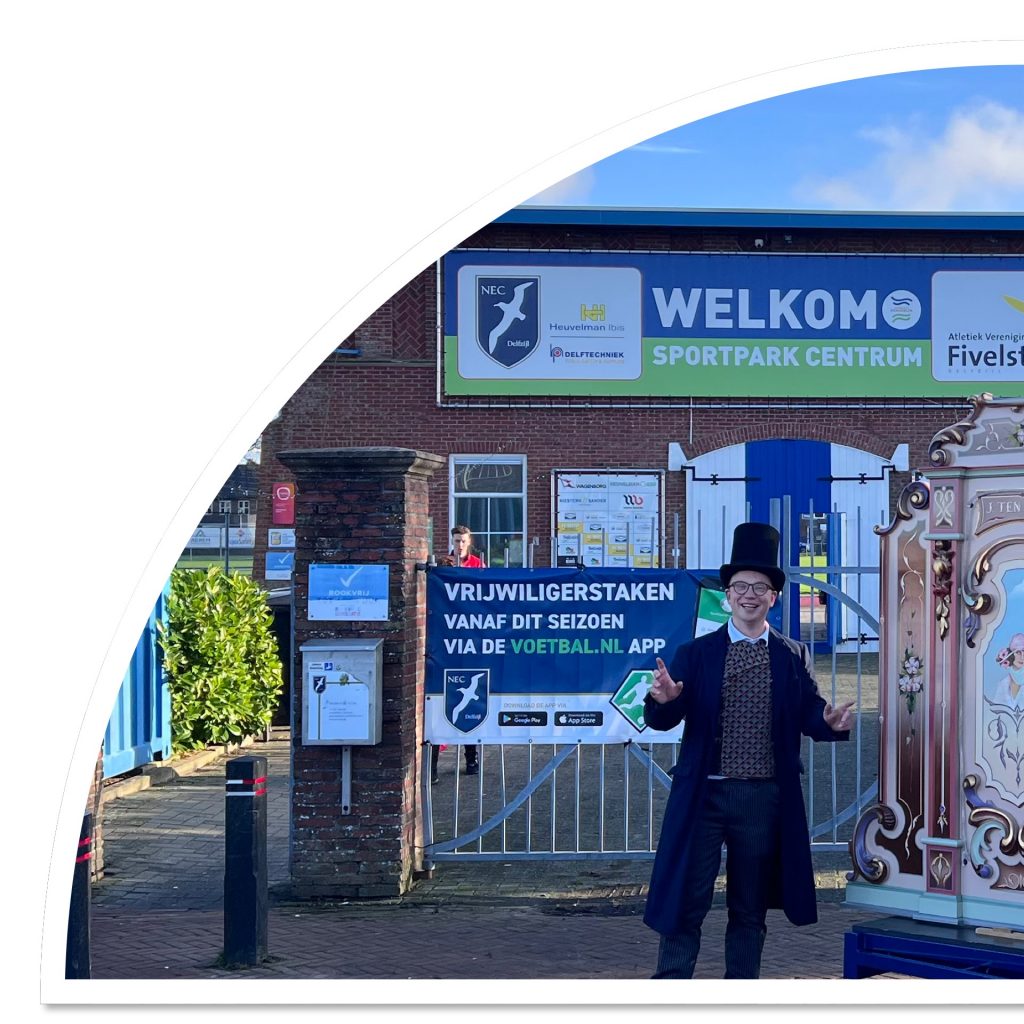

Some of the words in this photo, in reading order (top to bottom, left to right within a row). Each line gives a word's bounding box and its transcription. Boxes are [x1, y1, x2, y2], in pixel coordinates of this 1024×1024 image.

[481, 285, 506, 295] NEC
[651, 287, 877, 329] WELKOM
[550, 323, 606, 331] Heuvelman
[948, 332, 983, 341] Atletiek
[565, 351, 625, 359] DELFTECHNIEK
[652, 345, 800, 366] SPORTPARK
[805, 347, 922, 367] CENTRUM
[998, 501, 1021, 513] TEN
[444, 582, 675, 602] VRIJWILIGERSTAKEN
[444, 614, 507, 630] VANAF
[512, 614, 543, 630] DIT
[548, 613, 625, 630] SEIZOEN
[444, 638, 477, 654] VIA
[482, 638, 506, 654] DE
[511, 638, 624, 654] VOETBAL.NL
[628, 638, 666, 654] APP
[447, 676, 466, 684] NEC
